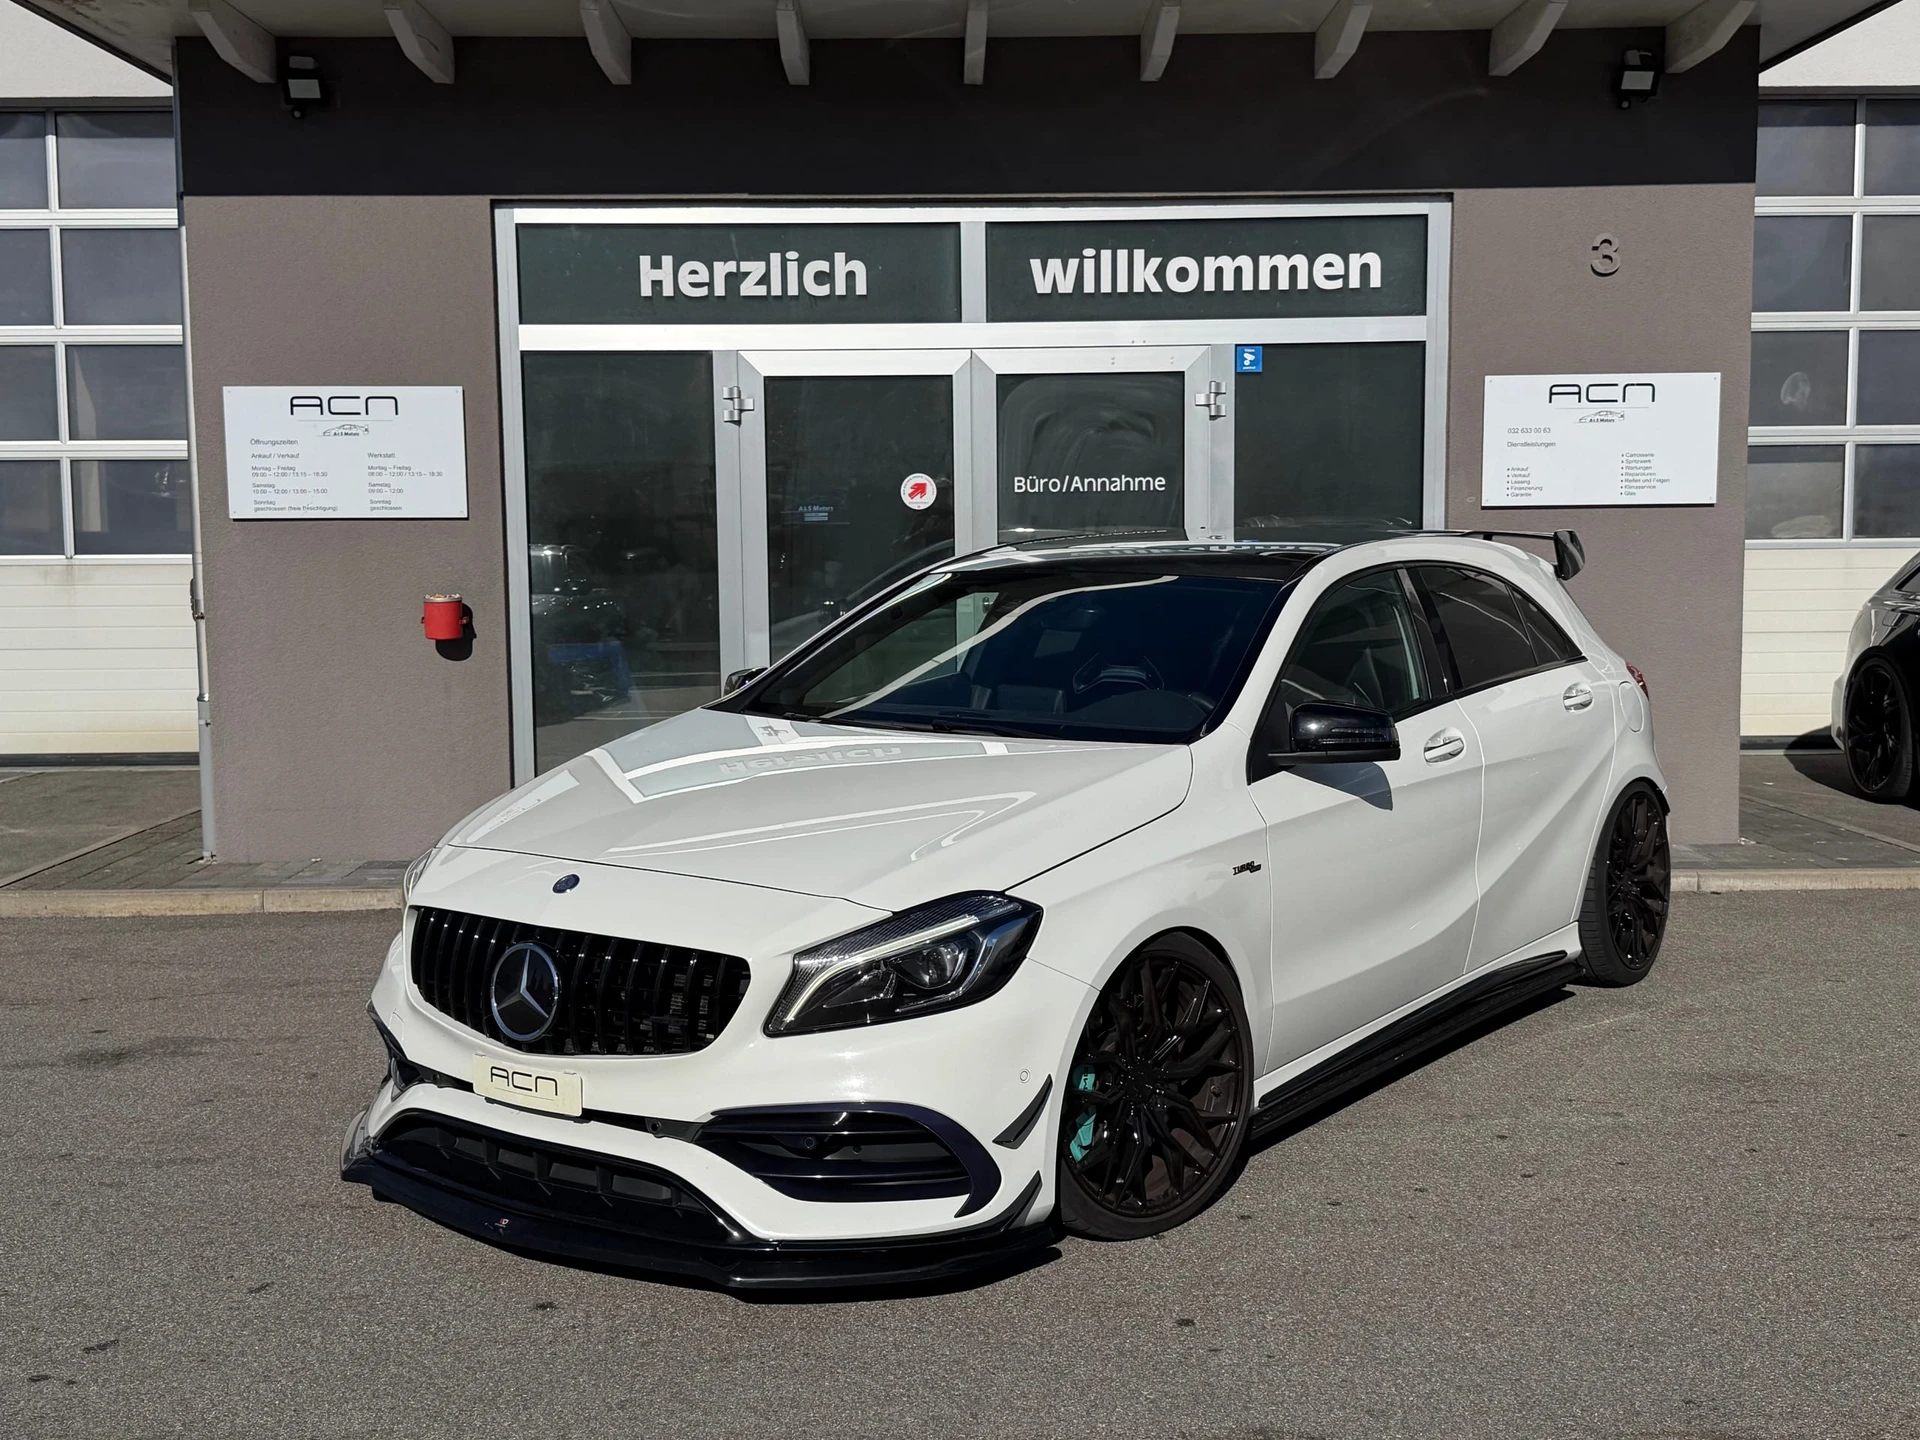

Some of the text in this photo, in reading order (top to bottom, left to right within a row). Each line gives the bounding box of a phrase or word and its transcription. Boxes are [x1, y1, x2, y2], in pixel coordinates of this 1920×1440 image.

[1591, 233, 1620, 278] 3
[640, 248, 1381, 296] Herzlich willkommen
[290, 396, 398, 415] ACN
[1549, 383, 1655, 403] ACN
[1014, 475, 1165, 492] Büro/Annahme
[491, 1066, 557, 1096] ACN
